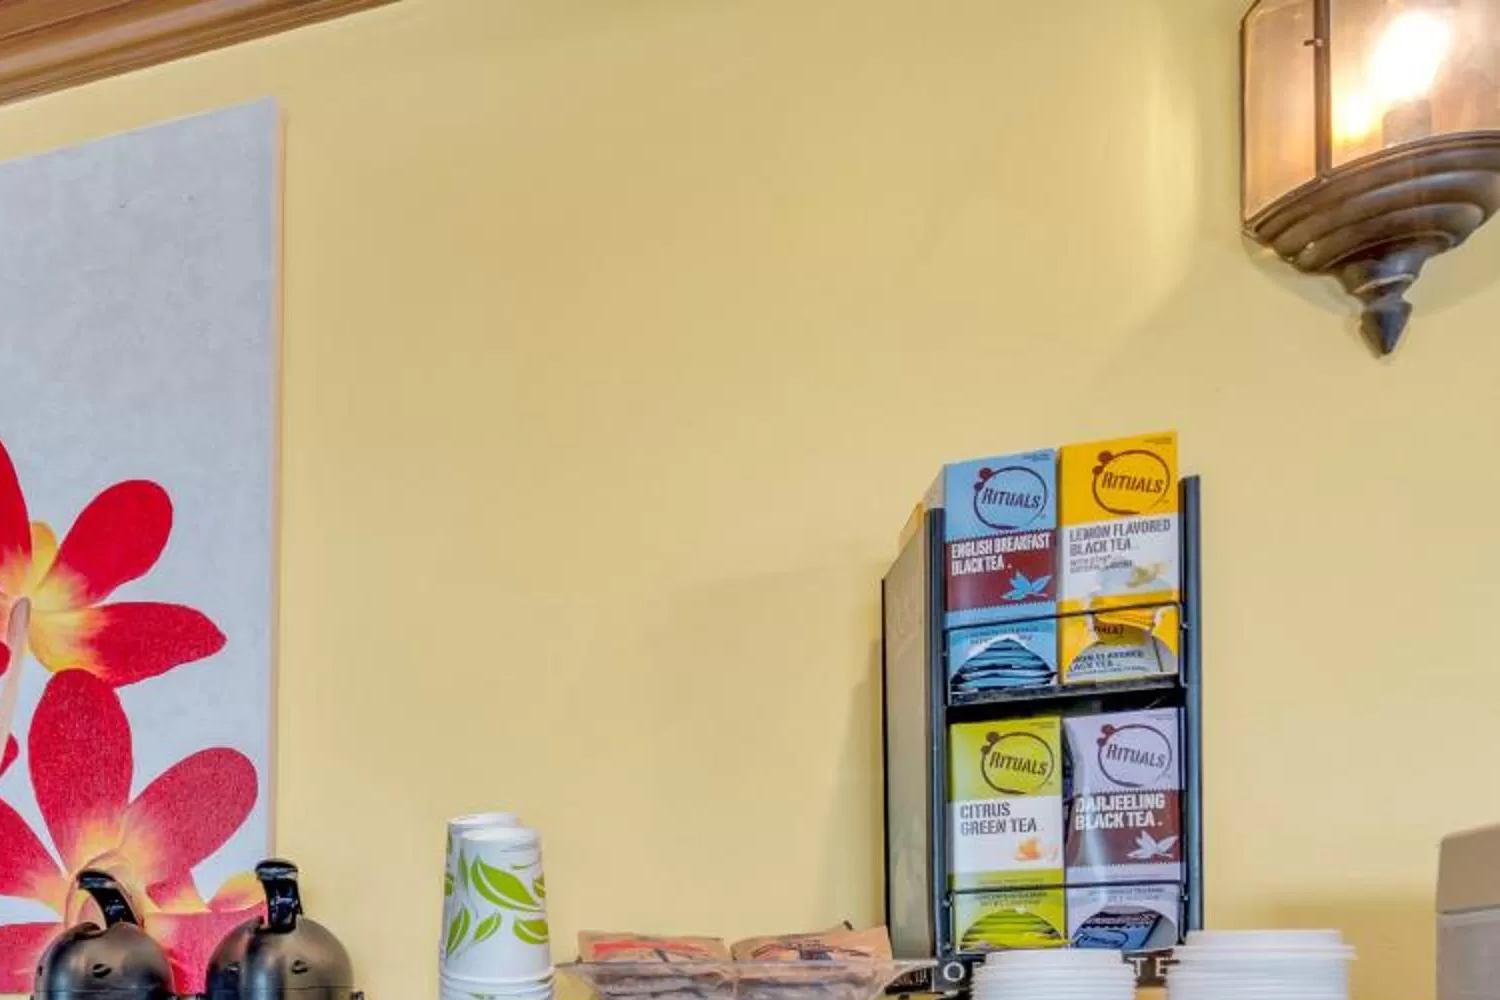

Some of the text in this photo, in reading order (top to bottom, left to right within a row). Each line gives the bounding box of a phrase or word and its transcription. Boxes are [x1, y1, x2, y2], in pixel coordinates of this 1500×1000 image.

[1102, 471, 1164, 494] RITUALS
[981, 487, 1042, 509] RITUALS
[1069, 518, 1171, 542] LEMON FLAVORED
[951, 532, 1051, 559] ENGLISH BREAKFAST
[1069, 538, 1131, 557] BLACK TEA
[951, 557, 985, 577] BLACK
[989, 751, 1049, 776] RITUALS
[1106, 743, 1166, 767] RITUALS
[960, 801, 1011, 819] CITRUS
[1075, 793, 1165, 813] DARJEELING
[960, 817, 1037, 837] GREEN TEA
[1075, 811, 1125, 831] BLACK
